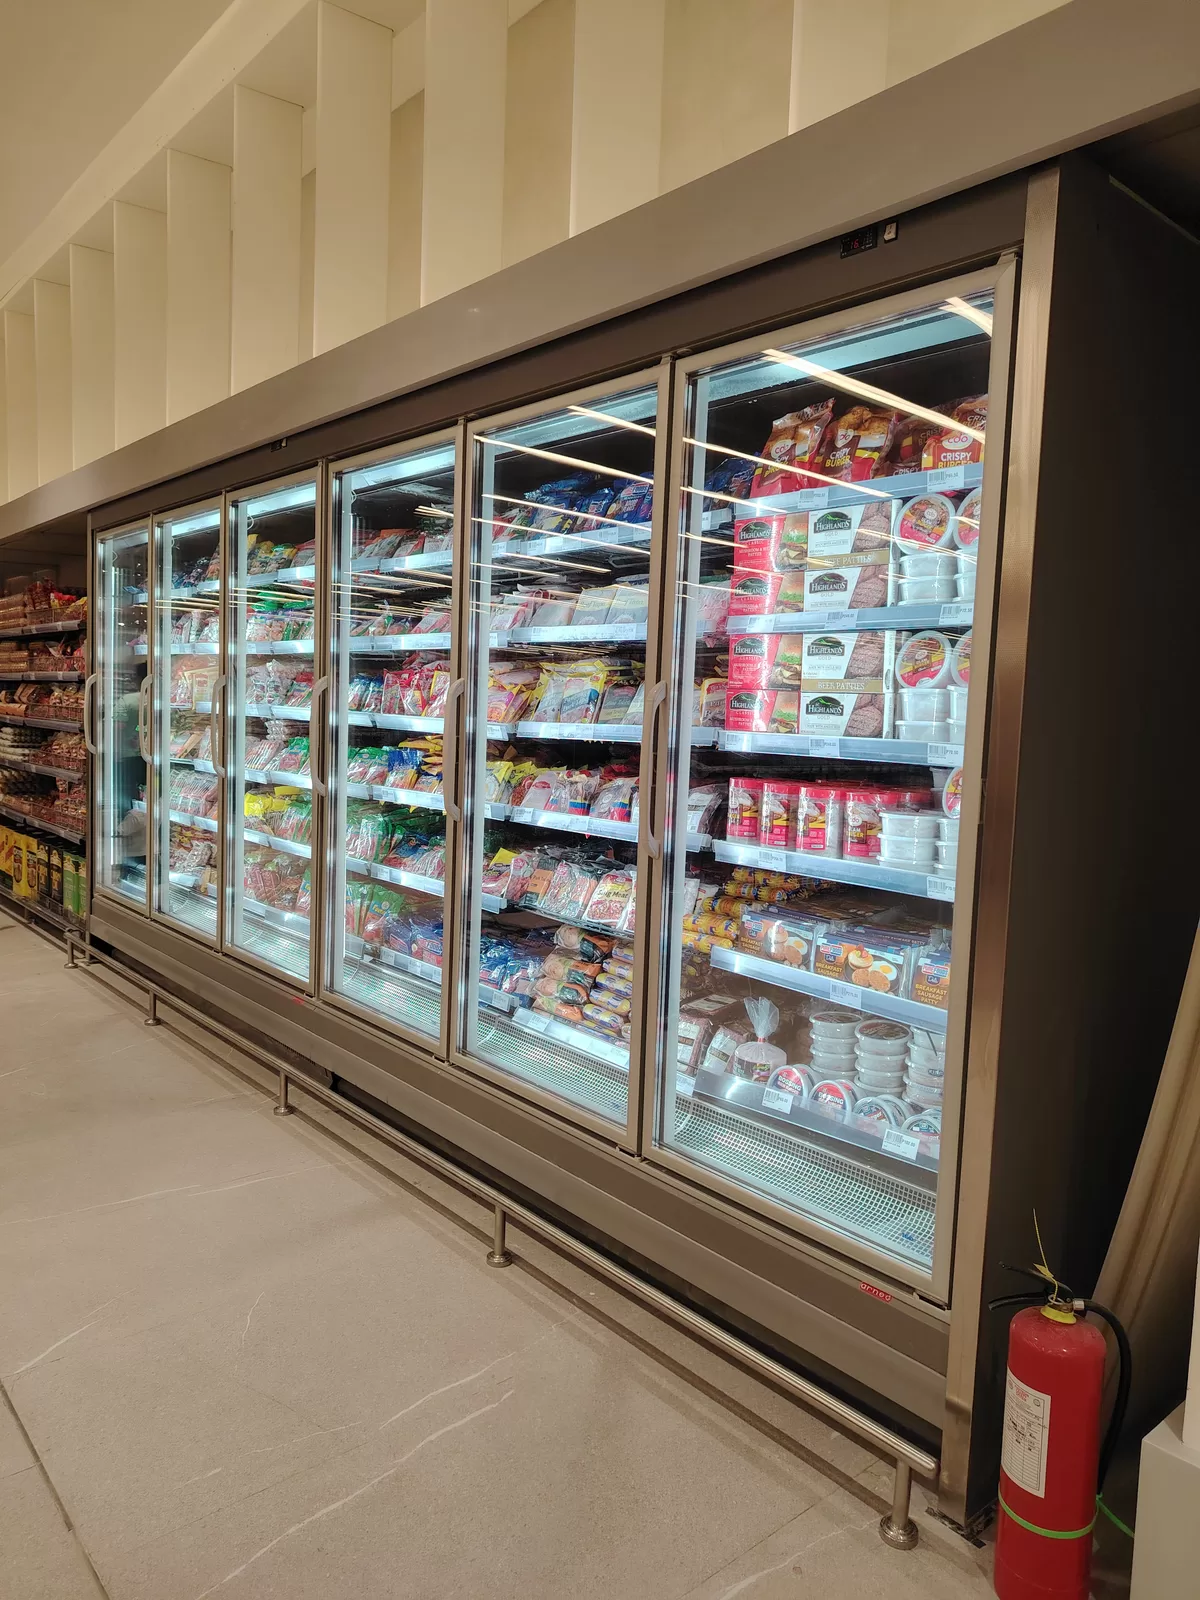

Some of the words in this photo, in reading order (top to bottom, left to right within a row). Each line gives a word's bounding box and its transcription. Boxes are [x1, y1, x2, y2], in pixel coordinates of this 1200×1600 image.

[940, 451, 972, 462] CRISPY
[816, 519, 852, 531] HIGHLANDS
[810, 581, 847, 592] HIGHLANDS
[809, 646, 844, 655] HIGHLANDS
[836, 682, 865, 690] PATTIES
[808, 704, 843, 714] HIGHLANDS
[815, 962, 843, 973] BREAKFAST
[817, 968, 840, 978] SAUSAGE
[915, 983, 948, 995] BREAKFAST
[917, 990, 944, 1001] SAUSAGE
[920, 996, 940, 1005] PATTY
